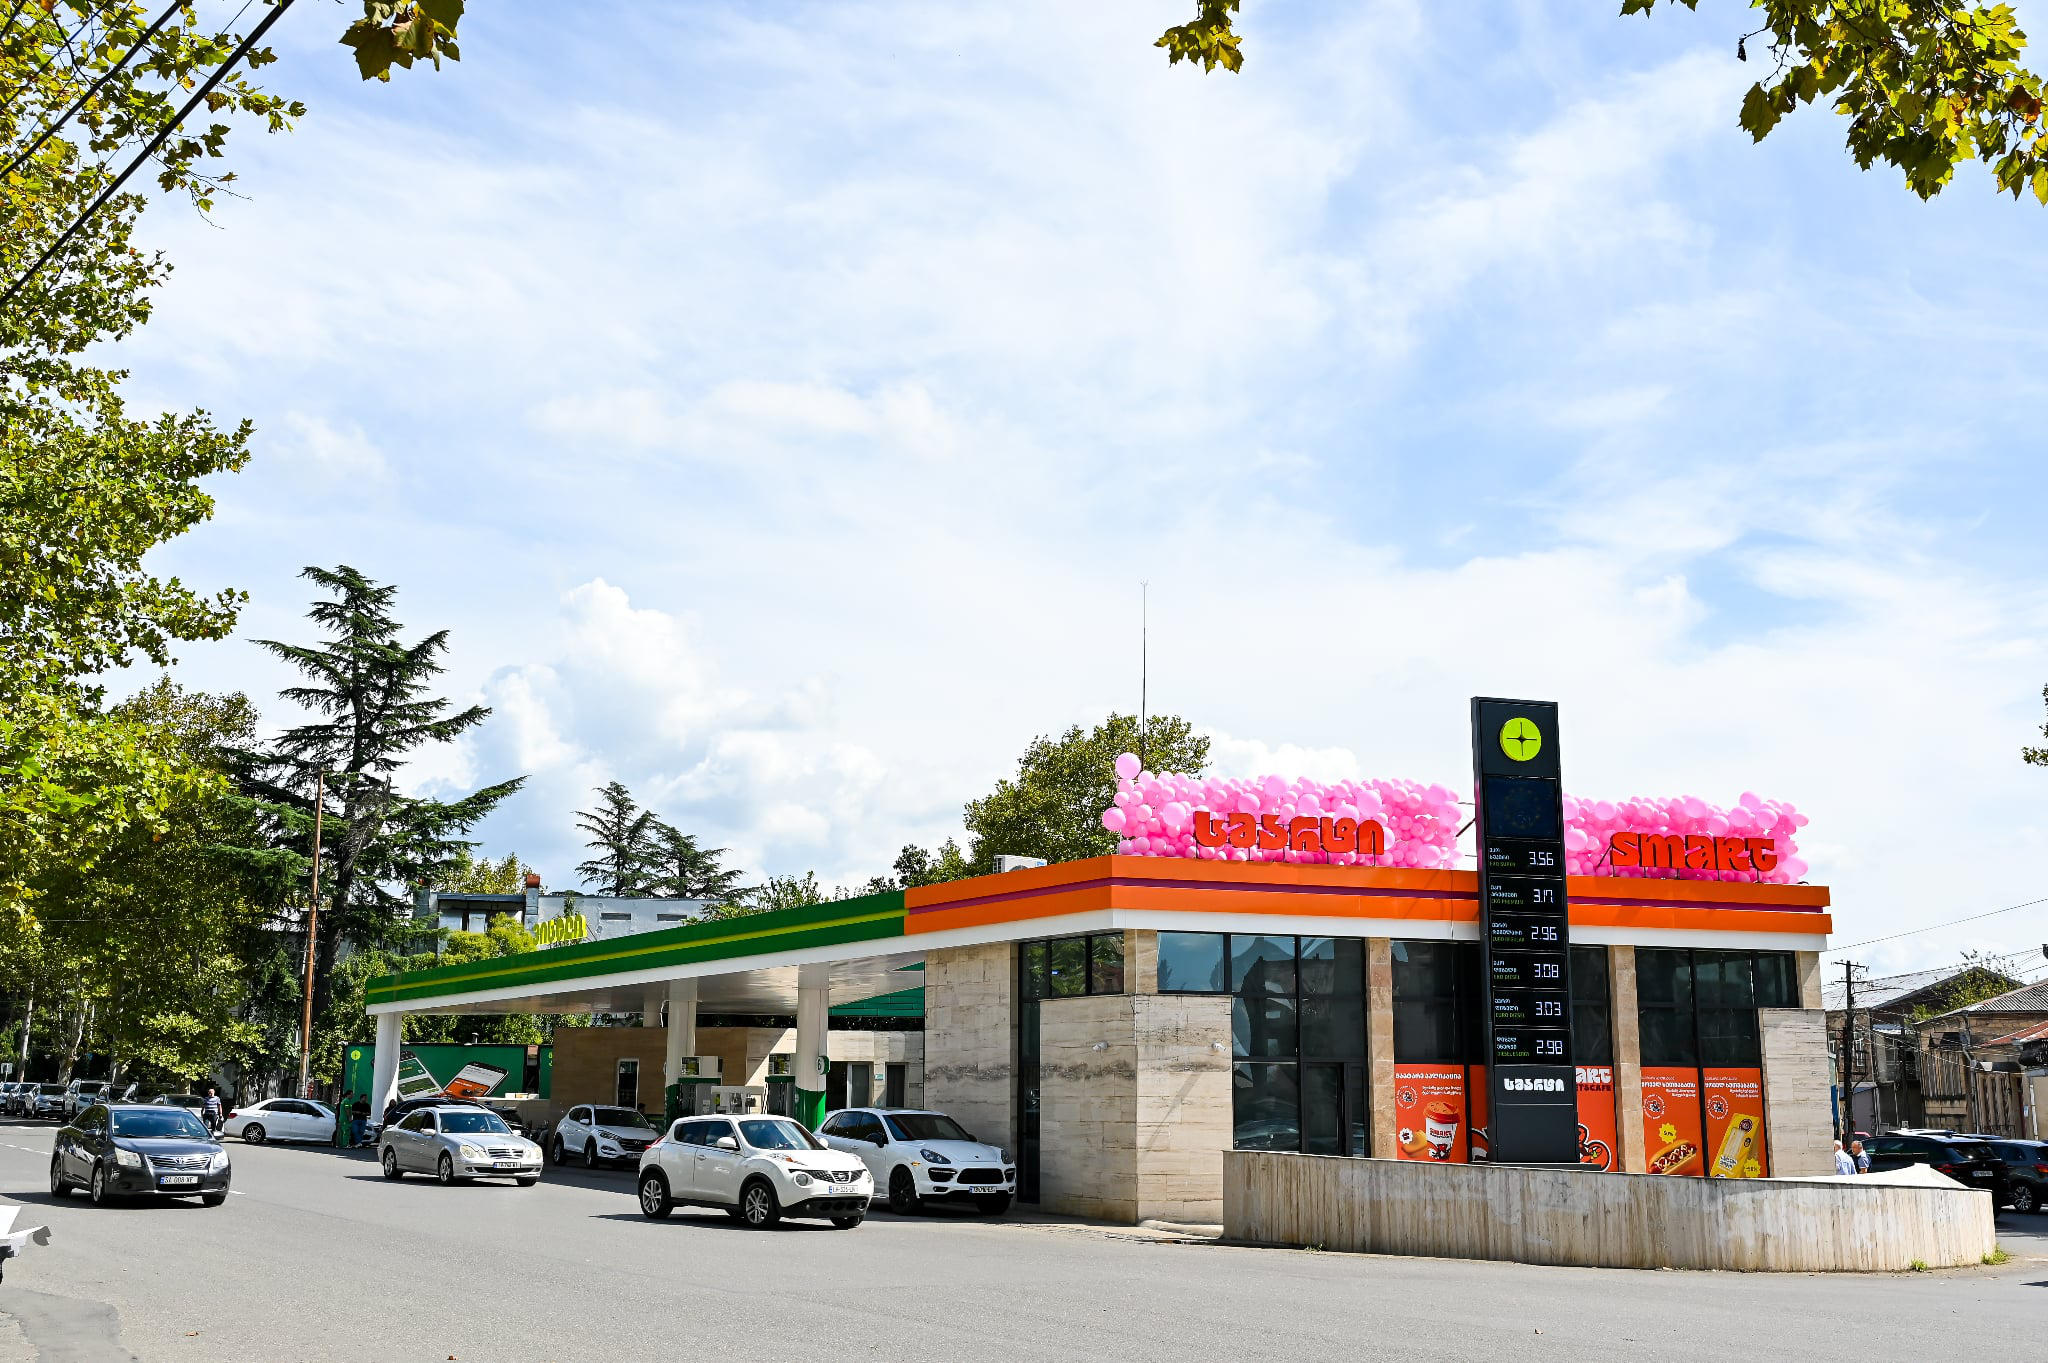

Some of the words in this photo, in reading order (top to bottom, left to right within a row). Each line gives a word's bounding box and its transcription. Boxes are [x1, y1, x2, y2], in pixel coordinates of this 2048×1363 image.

[1193, 811, 1385, 855] სმარტი
[1528, 851, 1554, 866] 3.56
[1533, 888, 1554, 903] 3.17
[1531, 926, 1557, 941] 2.96
[1533, 963, 1559, 978] 3.08
[1535, 1001, 1562, 1016] 3.03
[1536, 1039, 1563, 1055] 2.98
[1503, 1078, 1565, 1092] სმარტი
